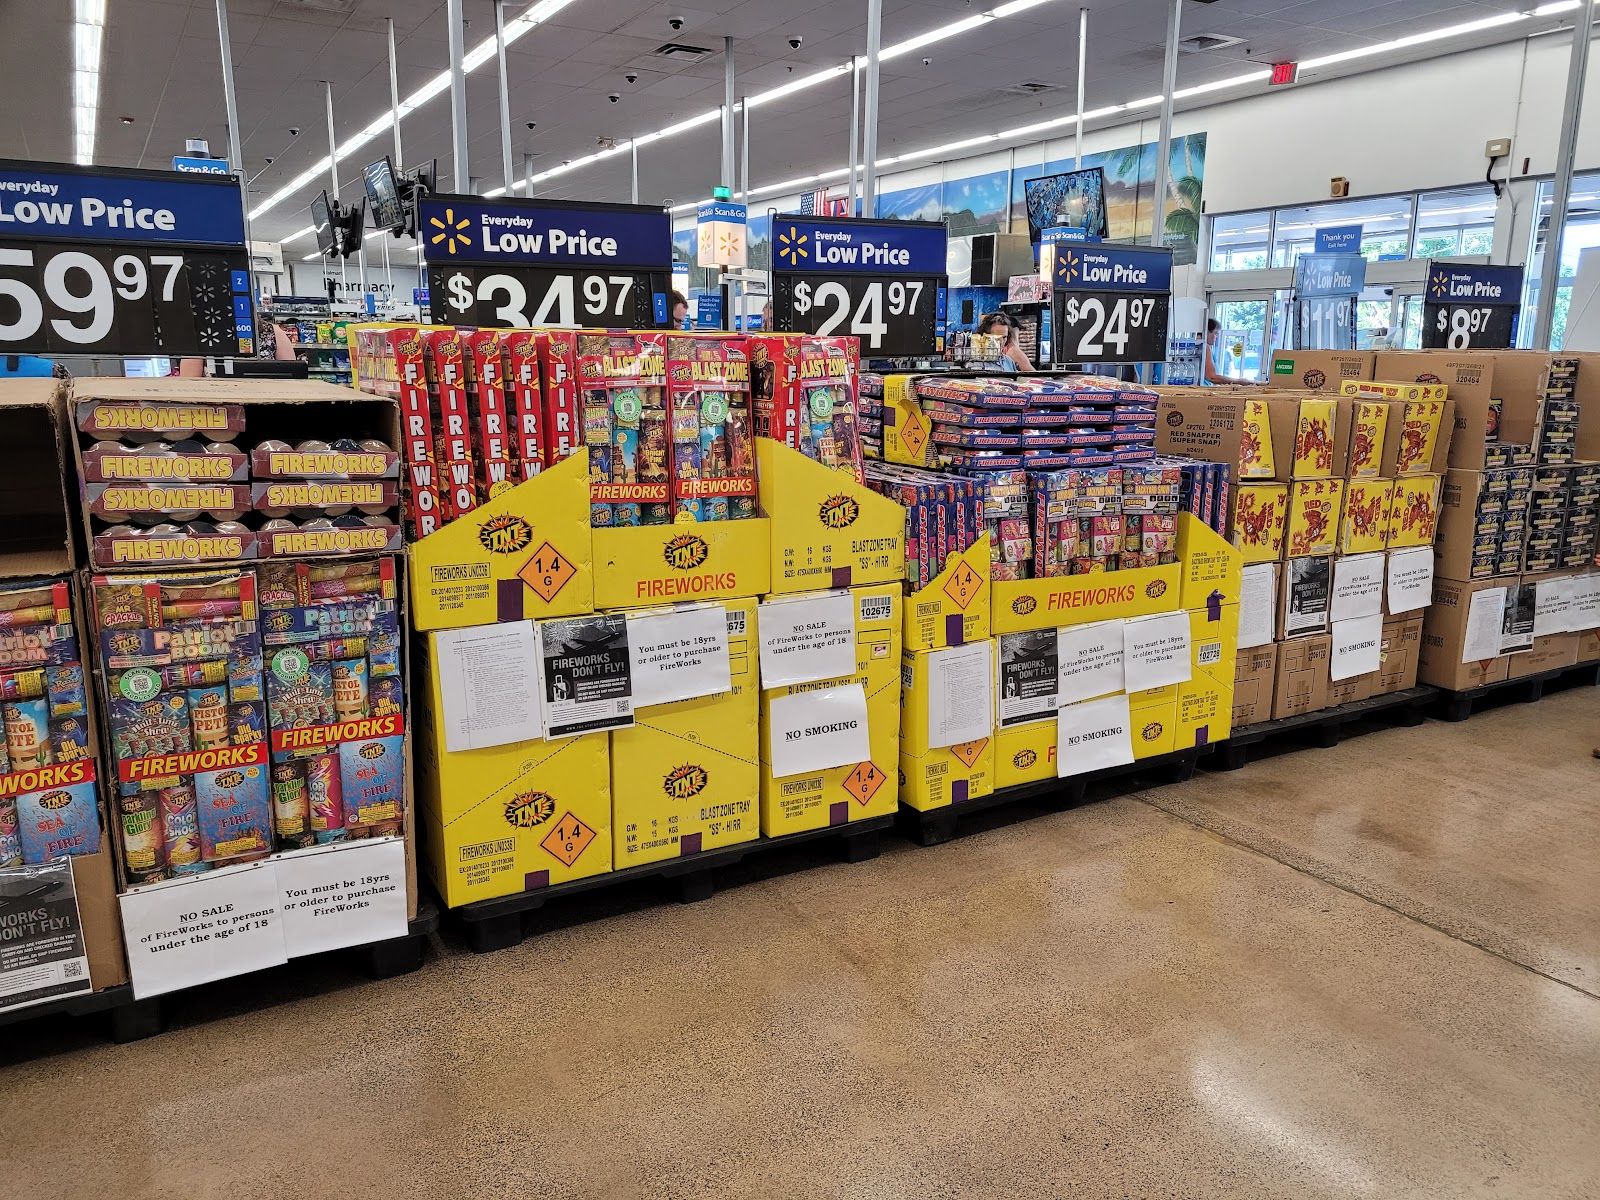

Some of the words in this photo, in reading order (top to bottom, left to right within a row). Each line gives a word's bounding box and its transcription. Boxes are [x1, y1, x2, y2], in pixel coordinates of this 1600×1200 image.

[0, 181, 59, 197] veryday
[0, 199, 73, 225] Low
[81, 197, 176, 231] Price
[481, 213, 533, 229] Everyday
[714, 207, 746, 218] Scan&Go
[483, 226, 544, 254] Low
[548, 228, 618, 257] Price
[815, 230, 852, 243] Everyday
[1322, 234, 1343, 242] Thank
[1343, 233, 1355, 242] you
[815, 243, 858, 265] Low
[862, 243, 910, 266] Price
[1083, 254, 1109, 264] Everyday
[113, 254, 184, 302] 97
[1082, 262, 1112, 283] Low
[1114, 264, 1147, 284] Price
[1317, 272, 1332, 288] Low
[1333, 272, 1351, 288] Price
[1451, 274, 1471, 282] Everyday
[583, 276, 634, 316] 97
[888, 281, 924, 316] 97
[1450, 283, 1474, 297] Low
[1475, 283, 1502, 298] Price
[1130, 298, 1155, 328] 97
[1470, 308, 1492, 333] 97
[236, 324, 252, 332] 600
[691, 362, 722, 381] BLAST
[724, 362, 749, 382] ZONE
[1198, 439, 1221, 447] SNAP)
[100, 456, 233, 479] FIREWORKS
[269, 453, 386, 475] FIREWORKS
[267, 483, 383, 505] FIREWORKS
[590, 485, 666, 499] FIREWORKS
[681, 479, 752, 494] FIREWORKS
[272, 528, 387, 553] FIREWORKS
[489, 528, 522, 550] TNT
[113, 538, 242, 562] FIREWORKS
[434, 566, 468, 580] FIREWORKS
[535, 556, 561, 574] 1.4
[543, 576, 553, 587] G
[636, 572, 737, 599] FIREWORKS
[954, 572, 972, 587] 1.4
[959, 587, 967, 597] G
[1047, 584, 1136, 611] FIREWORKS
[304, 604, 376, 627] Patriot
[861, 605, 891, 617] 102675
[320, 621, 372, 637] BOOM
[807, 622, 827, 630] SALE
[154, 623, 236, 649] Patriot
[638, 644, 655, 653] You
[657, 641, 678, 650] must
[694, 636, 716, 645] 18yrs
[777, 634, 813, 644] FireWorks
[824, 629, 851, 637] persons
[1145, 641, 1159, 649] must
[1167, 636, 1184, 644] 18yrs
[171, 643, 231, 659] BOOM
[649, 653, 670, 663] older
[684, 645, 721, 658] purchase
[773, 646, 796, 654] under
[798, 643, 810, 651] the
[1089, 645, 1105, 654] SALE
[1140, 650, 1154, 658] older
[1162, 644, 1186, 654] purchase
[1348, 640, 1375, 652] SMOKING
[552, 653, 610, 670] FIREWORKS
[660, 658, 702, 671] FireWorks
[1007, 659, 1045, 673] FIREWORKS
[1067, 656, 1095, 668] FireWorks
[1103, 649, 1124, 659] persons
[1145, 654, 1173, 665] FireWorks
[572, 664, 603, 678] DON'T
[605, 662, 624, 673] FLY!
[1020, 666, 1039, 679] DON'T
[1041, 666, 1055, 675] FLY!
[1063, 668, 1081, 677] under
[280, 717, 396, 749] FIREWORKS
[785, 730, 802, 741] NO
[805, 720, 858, 737] SMOKING
[1069, 736, 1080, 745] NO
[1082, 727, 1123, 741] SMOKING
[129, 746, 259, 779] FIREWORKS
[673, 772, 698, 794] TNT
[856, 767, 874, 783] 1.4
[513, 797, 544, 824] TNT
[700, 806, 719, 820] BLAST
[720, 802, 735, 817] ZONE
[736, 800, 751, 813] TRAY
[557, 825, 581, 843] 1.4
[462, 843, 493, 860] FIREWORKS
[565, 842, 574, 852] G
[285, 888, 309, 899] You
[312, 882, 341, 894] must
[343, 878, 356, 888] be
[360, 873, 390, 886] 18yrs
[284, 903, 297, 911] or
[299, 896, 328, 908] older
[331, 892, 343, 902] to
[347, 884, 397, 901] purchase
[179, 912, 198, 923] NO
[202, 904, 234, 919] SALE
[313, 900, 370, 917] FireWorks
[41, 916, 71, 933] FLY!
[141, 934, 153, 944] of
[156, 920, 214, 939] FireWorks
[217, 917, 229, 926] to
[232, 907, 275, 925] persons
[150, 939, 187, 953] under
[190, 933, 211, 945] the
[214, 927, 235, 940] age
[238, 923, 251, 934] of
[254, 919, 269, 930] 18
